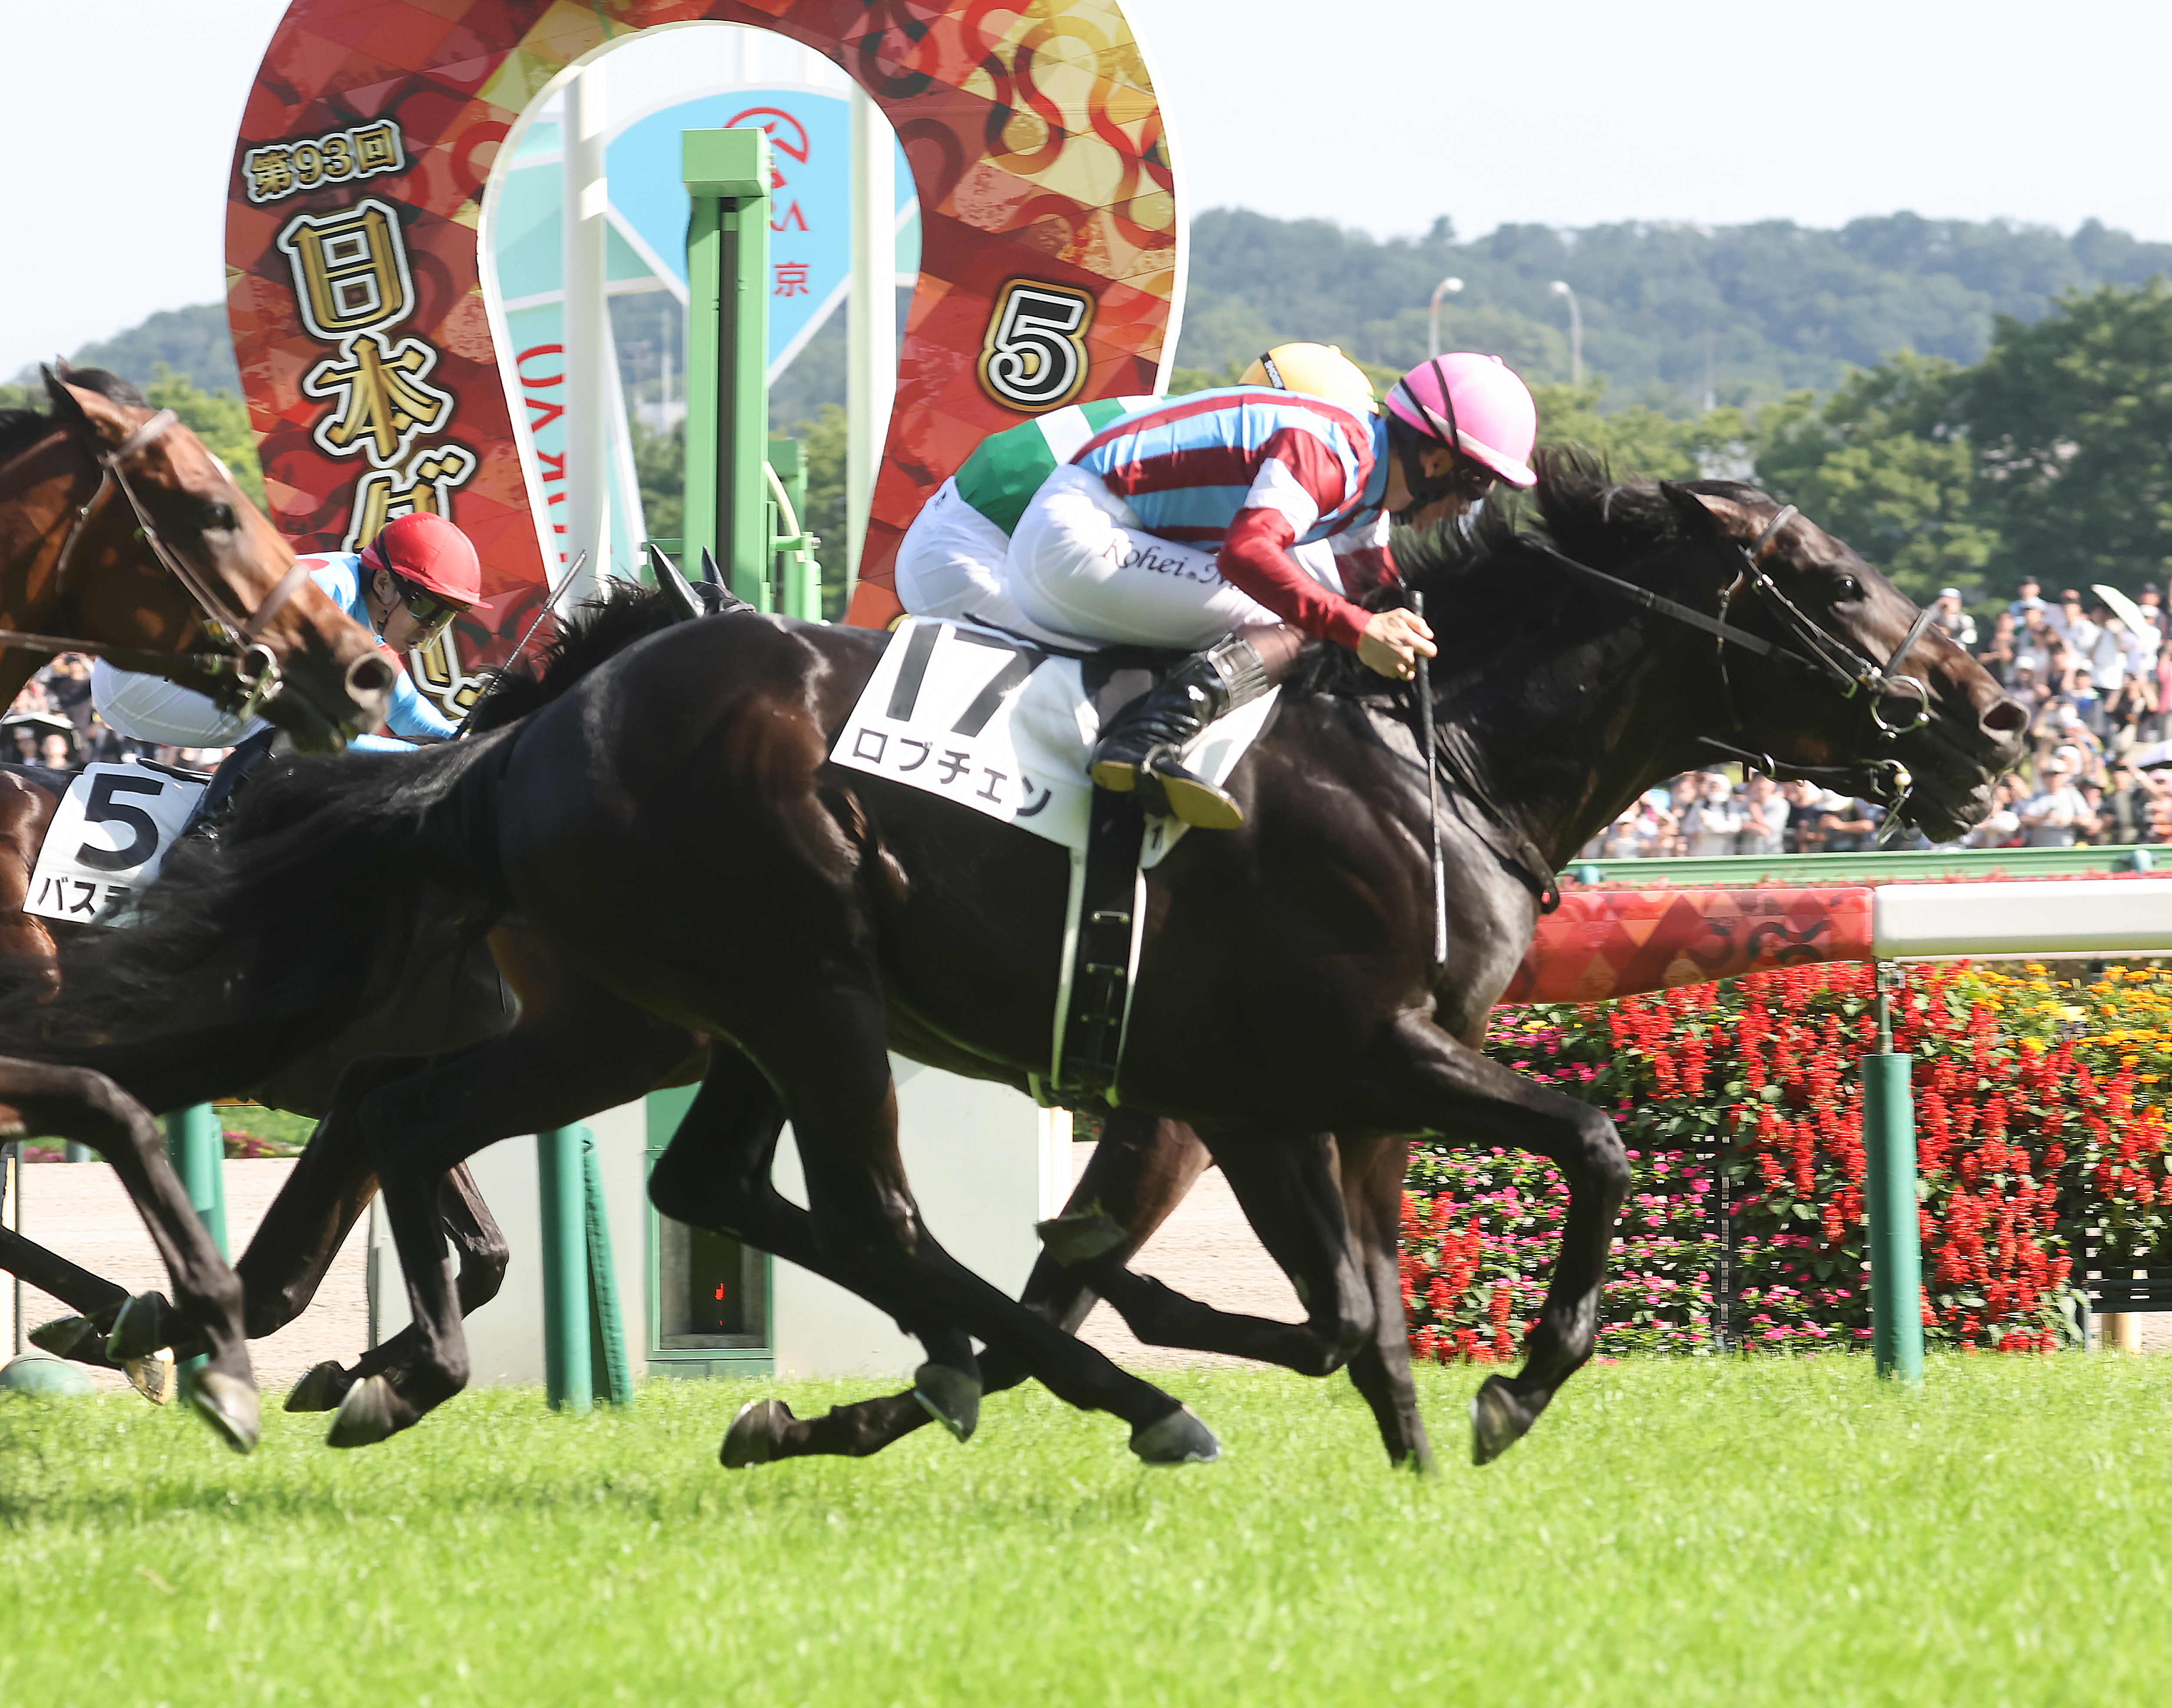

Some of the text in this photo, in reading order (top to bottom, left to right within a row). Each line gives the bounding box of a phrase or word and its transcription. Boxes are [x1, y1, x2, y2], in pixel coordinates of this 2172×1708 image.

[243, 120, 404, 202] 第93回
[979, 279, 1093, 411] 5
[886, 623, 1046, 737] 17
[76, 773, 164, 871] 5
